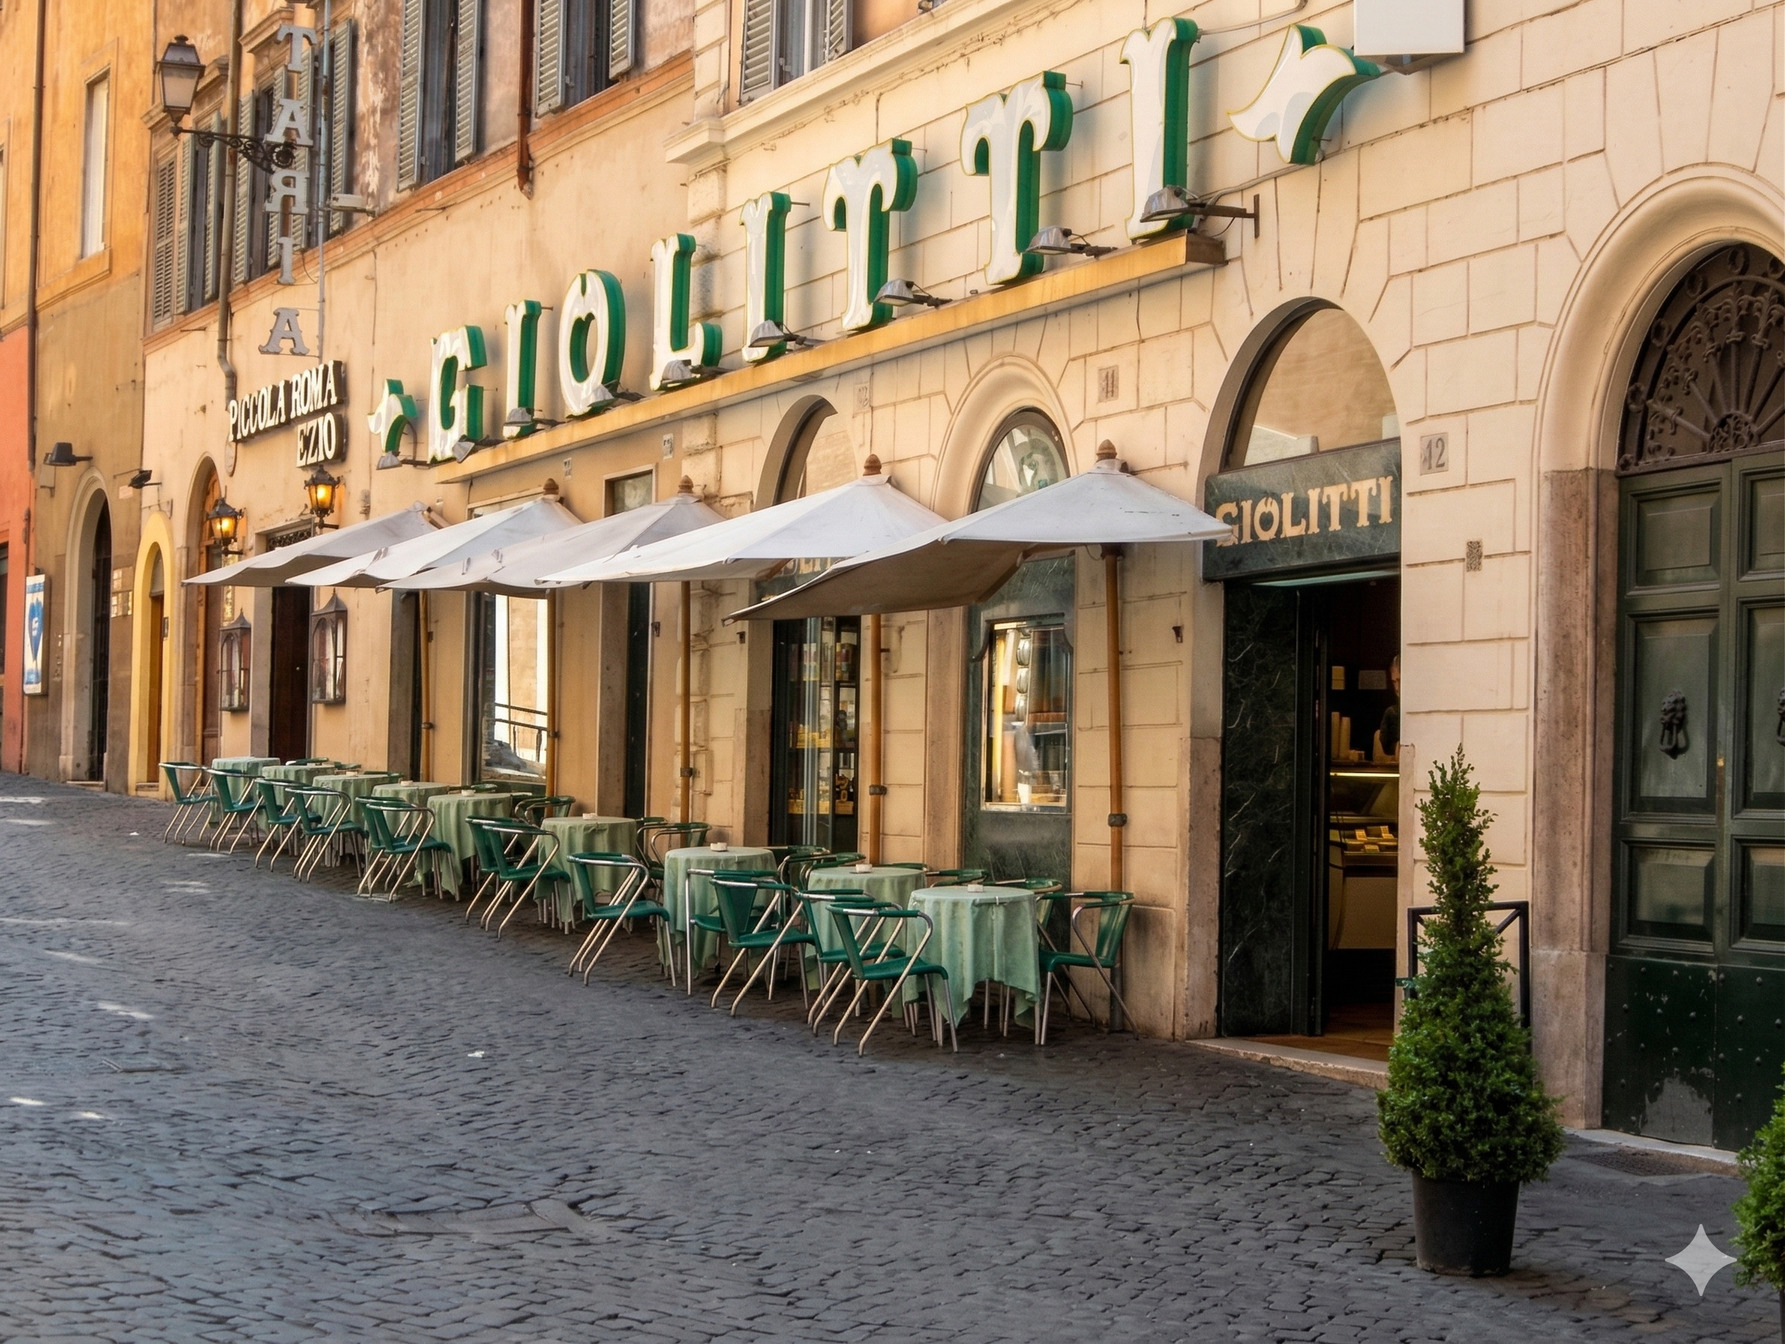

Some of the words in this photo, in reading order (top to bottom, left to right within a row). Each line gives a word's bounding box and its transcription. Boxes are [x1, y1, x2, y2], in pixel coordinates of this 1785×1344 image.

[429, 17, 1198, 463] GIOLITTI
[228, 379, 288, 442] PICCOLA
[290, 360, 340, 419] ROMA
[296, 412, 338, 467] EZIO
